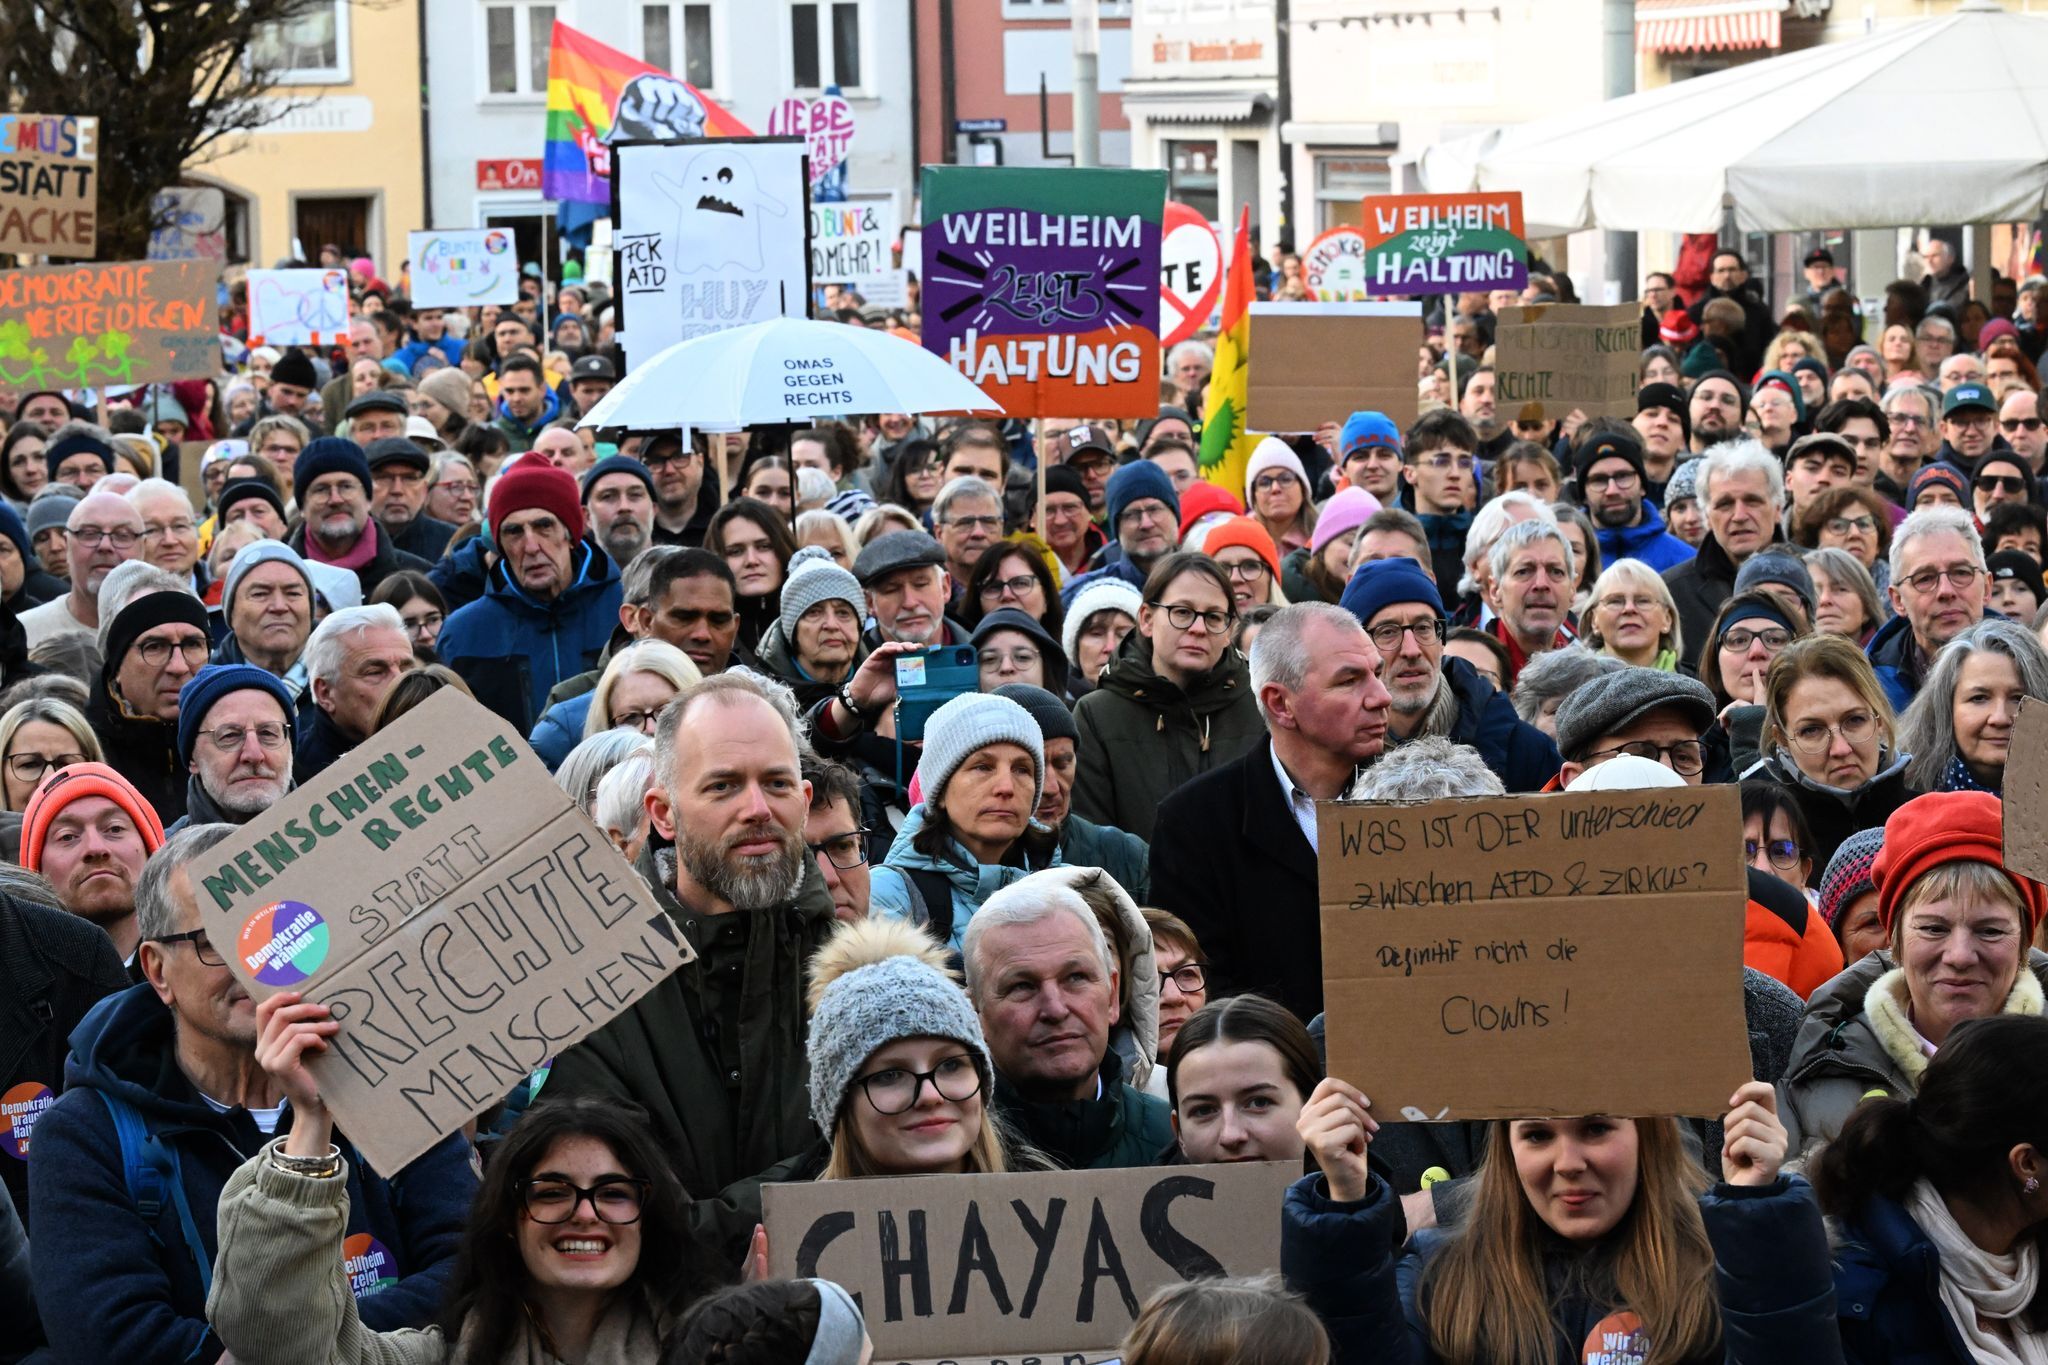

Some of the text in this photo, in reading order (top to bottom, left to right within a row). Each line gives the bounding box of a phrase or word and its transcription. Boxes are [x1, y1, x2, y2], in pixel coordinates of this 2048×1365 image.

[809, 130, 855, 157] ATT
[0, 161, 94, 199] STATT
[0, 206, 94, 245] ACKE
[942, 212, 1142, 248] WEILHEIM
[1375, 202, 1511, 234] WEILHEIM
[621, 237, 663, 265] FCK
[1408, 228, 1464, 258] zeigt
[1376, 248, 1515, 285] HALTUNG
[0, 264, 154, 309] DEMOKRATIE
[681, 280, 768, 320] HUY
[783, 357, 834, 370] OMAS
[949, 328, 1141, 386] HALTUNG
[784, 372, 844, 387] GEGEN
[1497, 371, 1553, 400] RECHTE
[784, 390, 853, 406] RECHTS
[361, 734, 518, 851] RECHTE
[201, 744, 425, 913] MENSCHEN-
[1422, 814, 1458, 849] IST
[1465, 808, 1540, 852] DER
[349, 824, 490, 945] STATT
[1490, 869, 1553, 900] AFD
[1563, 861, 1591, 896] &
[245, 911, 316, 970] Demokratie
[1474, 939, 1528, 964] nicht
[1546, 938, 1578, 961] die
[315, 832, 638, 1088] RECHTE
[1, 1096, 54, 1116] Demokratie
[11, 1111, 42, 1127] brauc
[351, 1267, 380, 1290] zeigt
[1602, 1331, 1631, 1351] Wir
